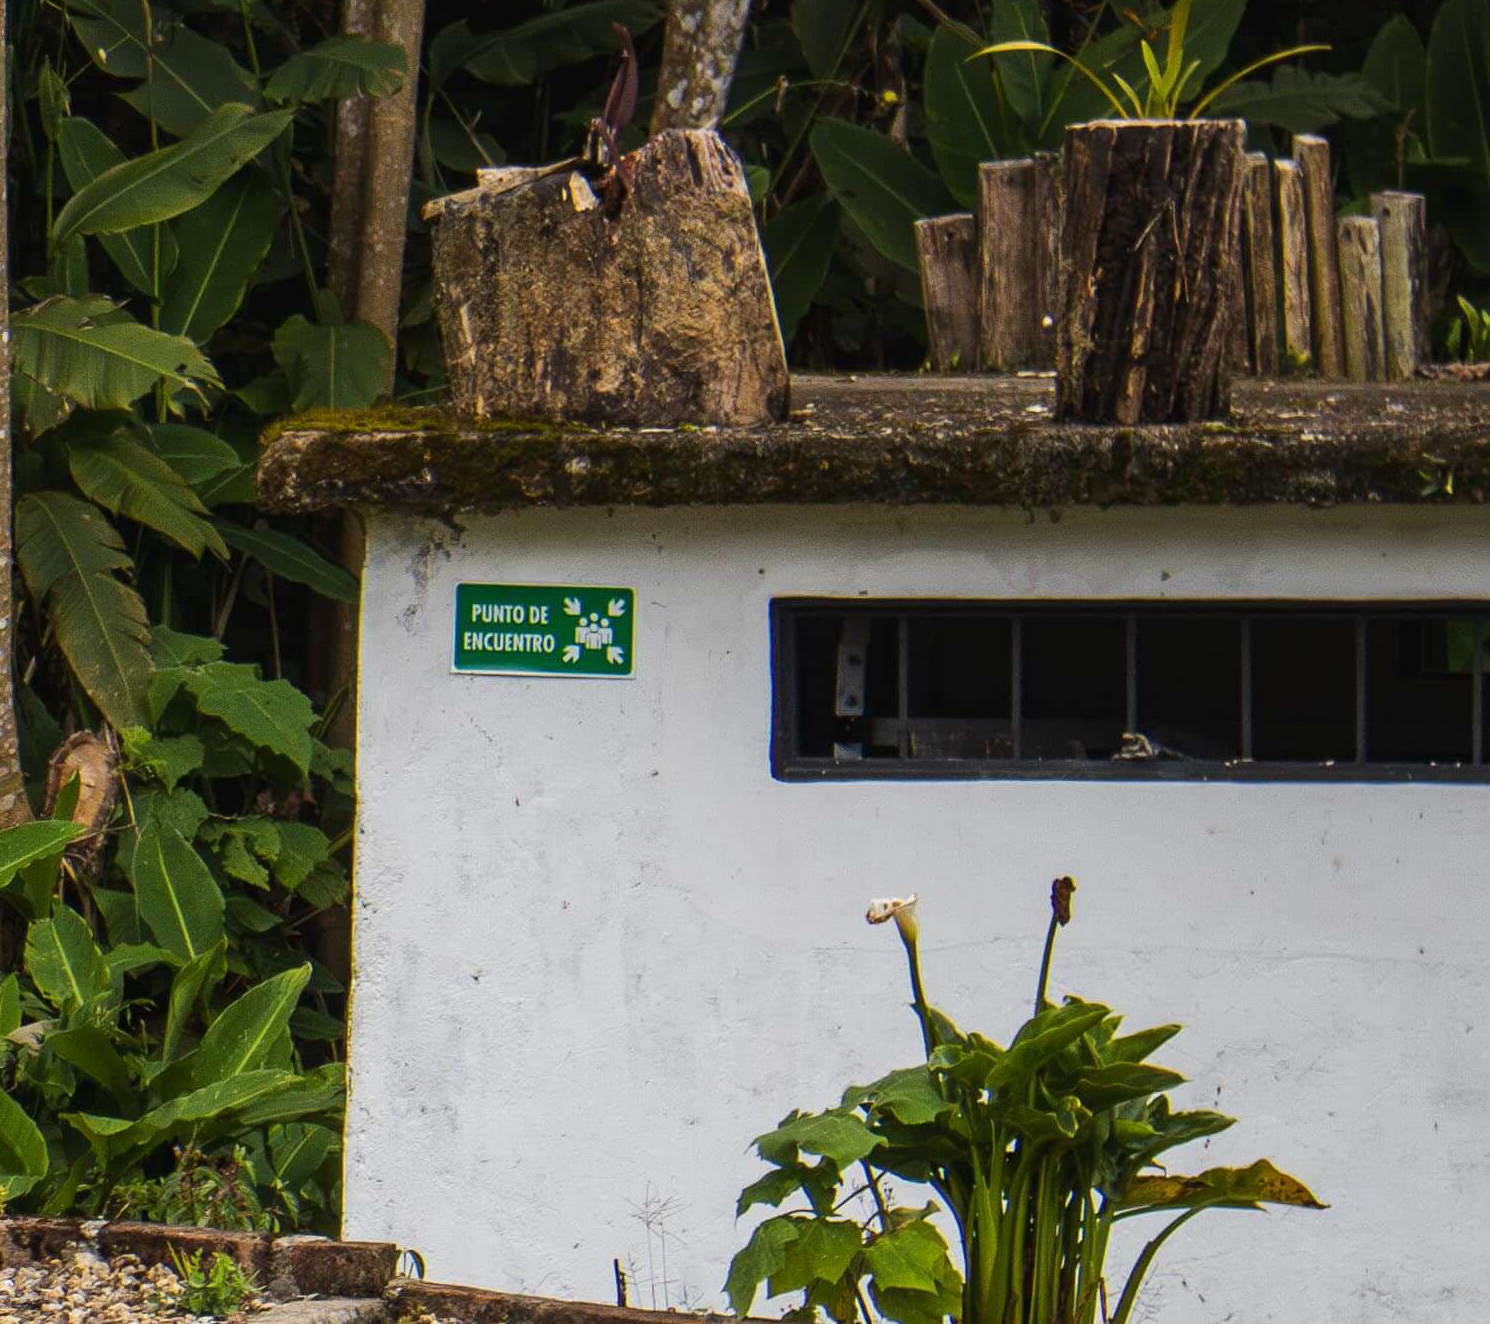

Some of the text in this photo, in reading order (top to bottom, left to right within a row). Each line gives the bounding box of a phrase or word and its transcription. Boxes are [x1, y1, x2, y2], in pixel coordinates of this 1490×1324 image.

[471, 603, 550, 625] PUNTO DE
[463, 631, 556, 653] ENCUENTRO
